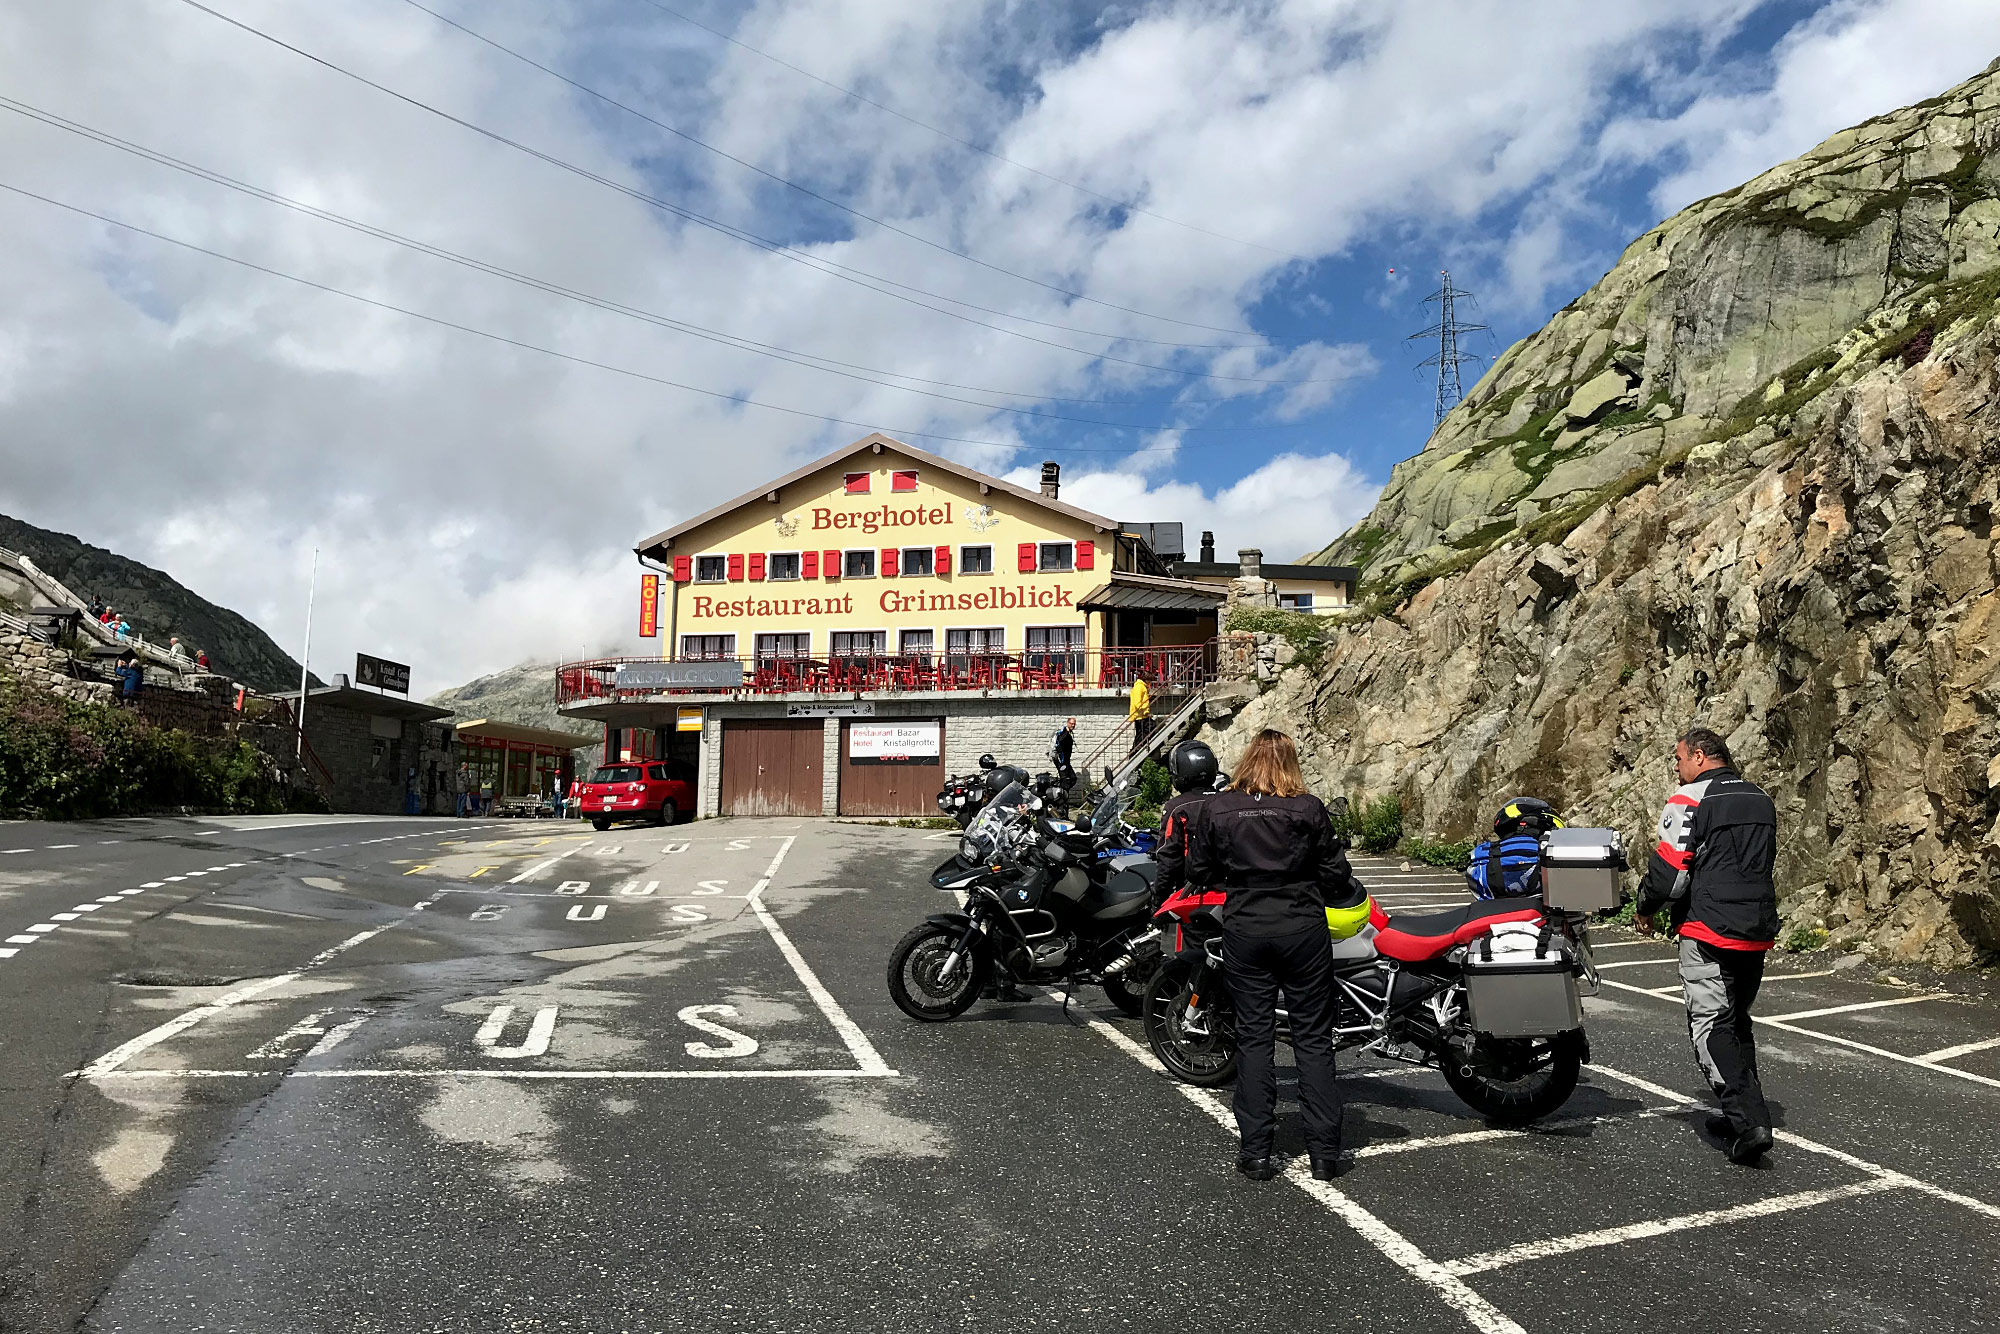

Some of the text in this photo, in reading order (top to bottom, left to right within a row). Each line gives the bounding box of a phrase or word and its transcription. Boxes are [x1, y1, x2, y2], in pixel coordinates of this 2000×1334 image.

[811, 502, 954, 534] Berghotel
[643, 575, 656, 635] HOTEL
[692, 585, 1074, 618] Restaurant Grimselblick
[853, 729, 920, 737] Restaurant Bazar
[883, 739, 935, 749] Kristallgrotte
[593, 839, 752, 855] BUS
[553, 880, 729, 896] BUS
[469, 904, 708, 922] BUS
